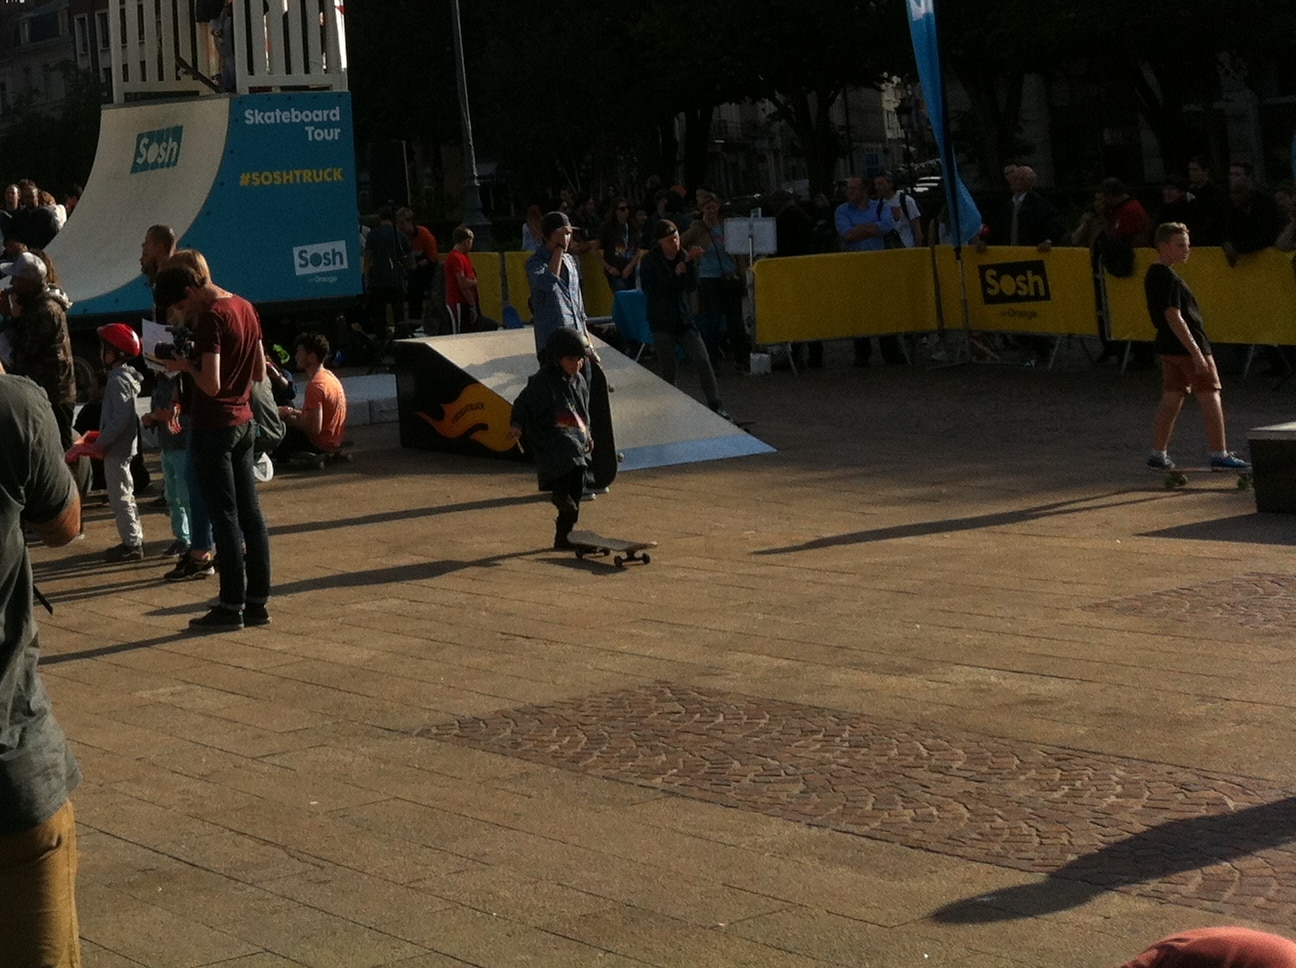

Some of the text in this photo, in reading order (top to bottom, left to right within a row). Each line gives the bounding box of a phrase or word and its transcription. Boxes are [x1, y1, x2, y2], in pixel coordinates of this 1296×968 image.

[244, 106, 341, 125] Skateboard
[305, 126, 341, 141] Tour
[135, 134, 179, 165] Sosh
[240, 167, 344, 187] #SOSHTRUCK
[298, 248, 344, 268] Sosh
[985, 268, 1046, 297] Sosh
